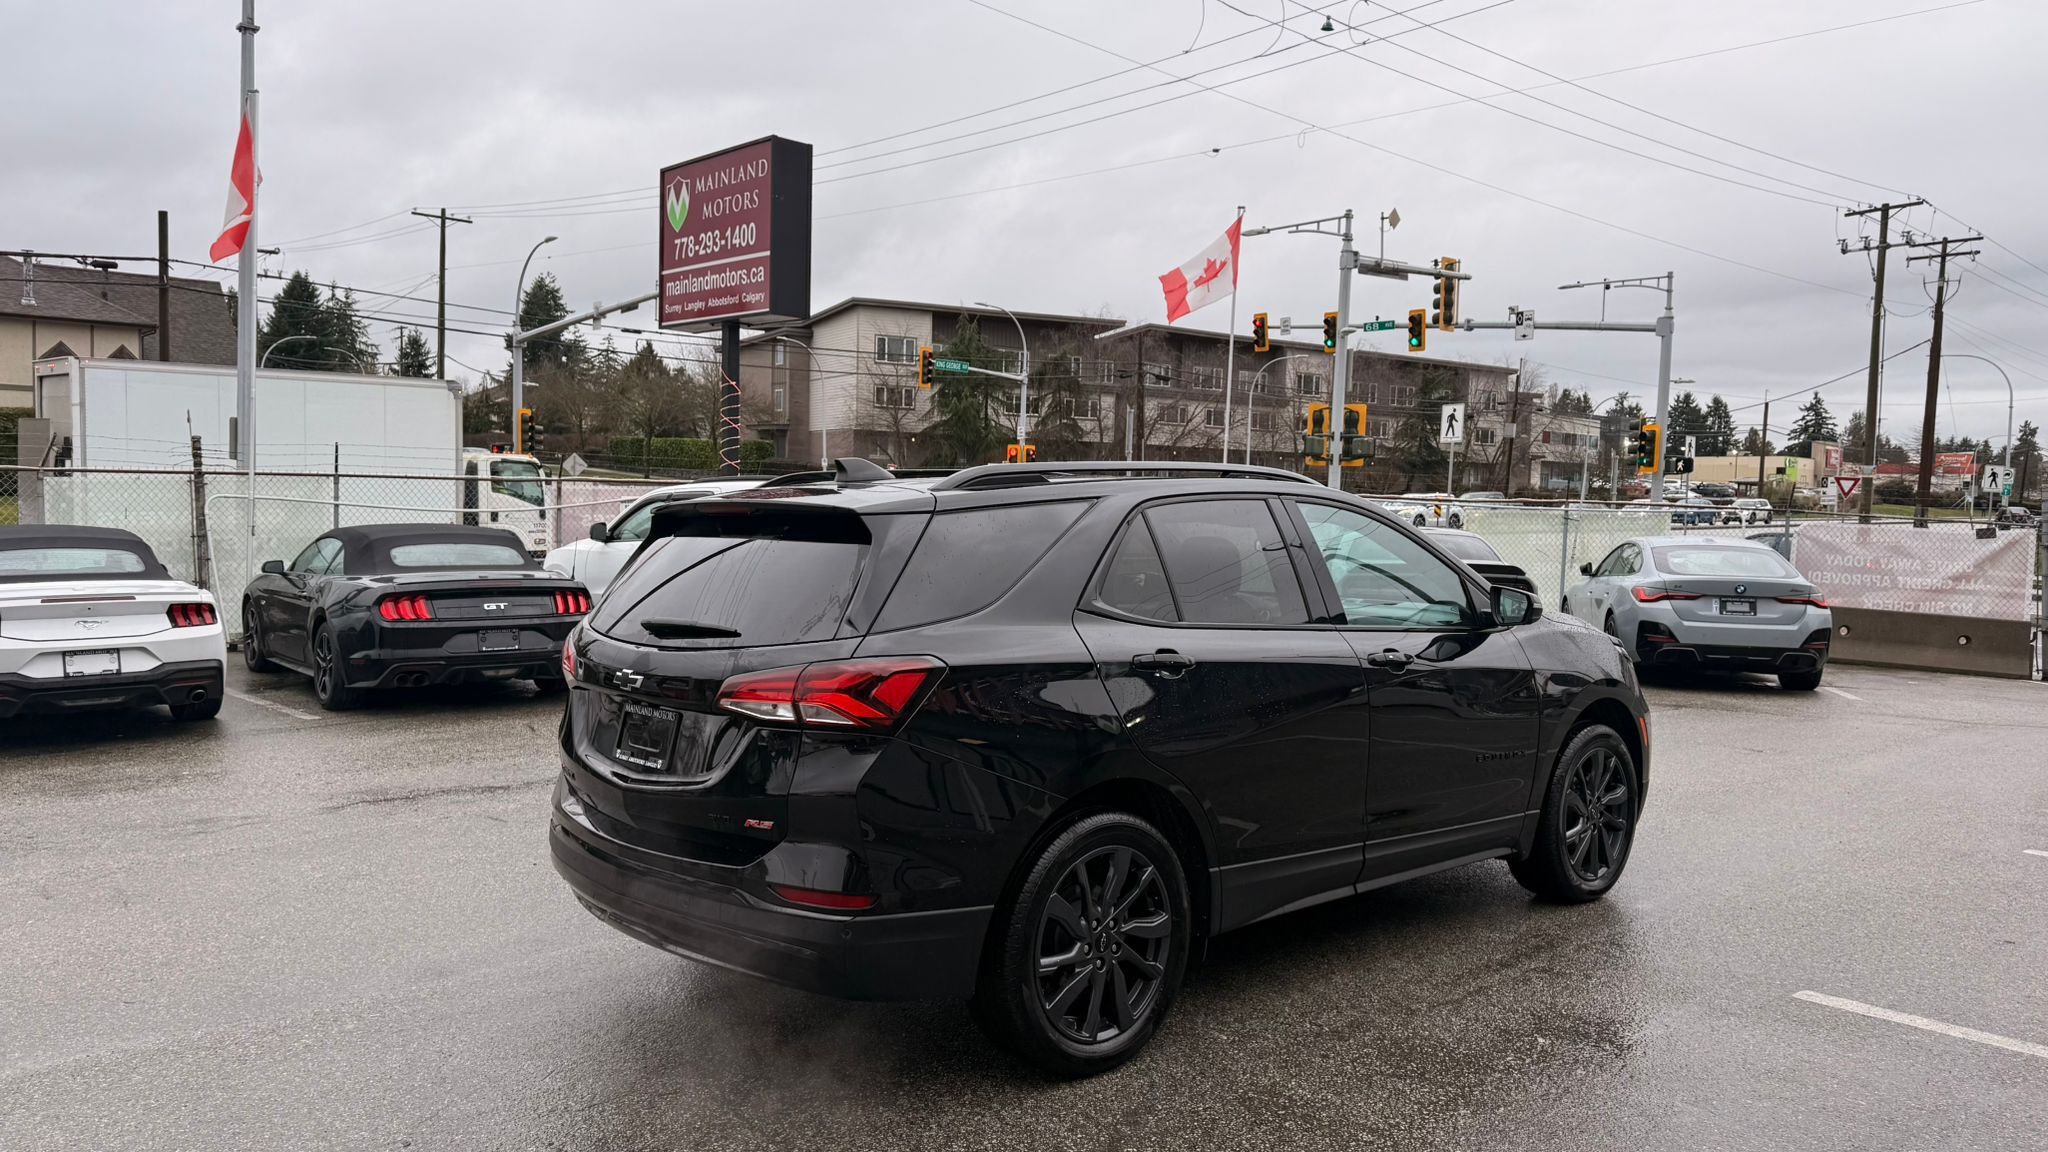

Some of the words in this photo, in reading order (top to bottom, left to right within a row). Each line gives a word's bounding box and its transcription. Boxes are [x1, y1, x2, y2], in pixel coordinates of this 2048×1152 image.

[695, 159, 768, 194] MAINLAND
[702, 189, 760, 220] MOTORS
[674, 222, 756, 261] 778-293-1400
[665, 265, 765, 297] mainlandmotors.ca
[665, 300, 682, 314] Surrey
[684, 297, 706, 312] Langley
[707, 293, 740, 308] Abbotsford
[742, 291, 765, 304] Calgary
[1365, 322, 1379, 331] 68
[483, 602, 509, 610] GT
